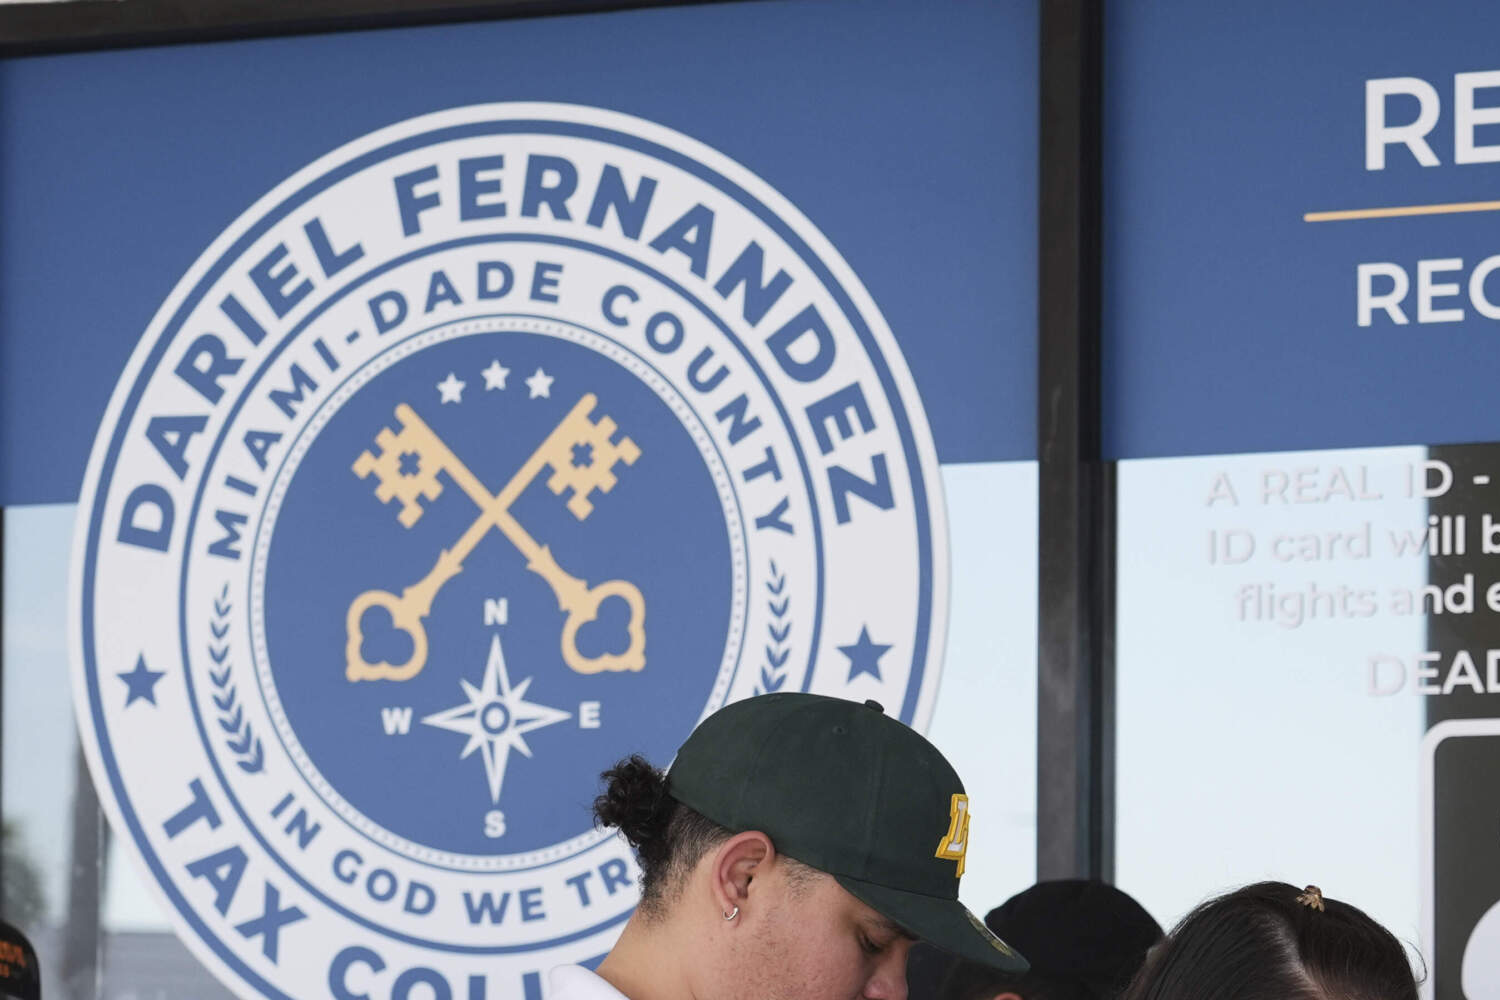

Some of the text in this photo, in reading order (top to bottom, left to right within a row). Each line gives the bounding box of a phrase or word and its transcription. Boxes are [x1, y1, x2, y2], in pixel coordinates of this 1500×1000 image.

[116, 152, 896, 554] DARIEL FERNANDEZ
[208, 261, 796, 560] MIAMI-DADE COUNTY
[1206, 470, 1240, 509] A
[1258, 464, 1384, 505] REAL
[1404, 460, 1453, 500] ID
[1206, 528, 1256, 566] ID
[1271, 520, 1372, 563] card
[1389, 515, 1466, 557] will
[483, 598, 508, 626] N
[1236, 582, 1378, 629] flights
[1390, 573, 1475, 616] and
[381, 707, 413, 735] W
[578, 701, 601, 729] E
[483, 810, 507, 838] S
[162, 778, 308, 965] TAX
[271, 791, 636, 926] IN GOD WE TR
